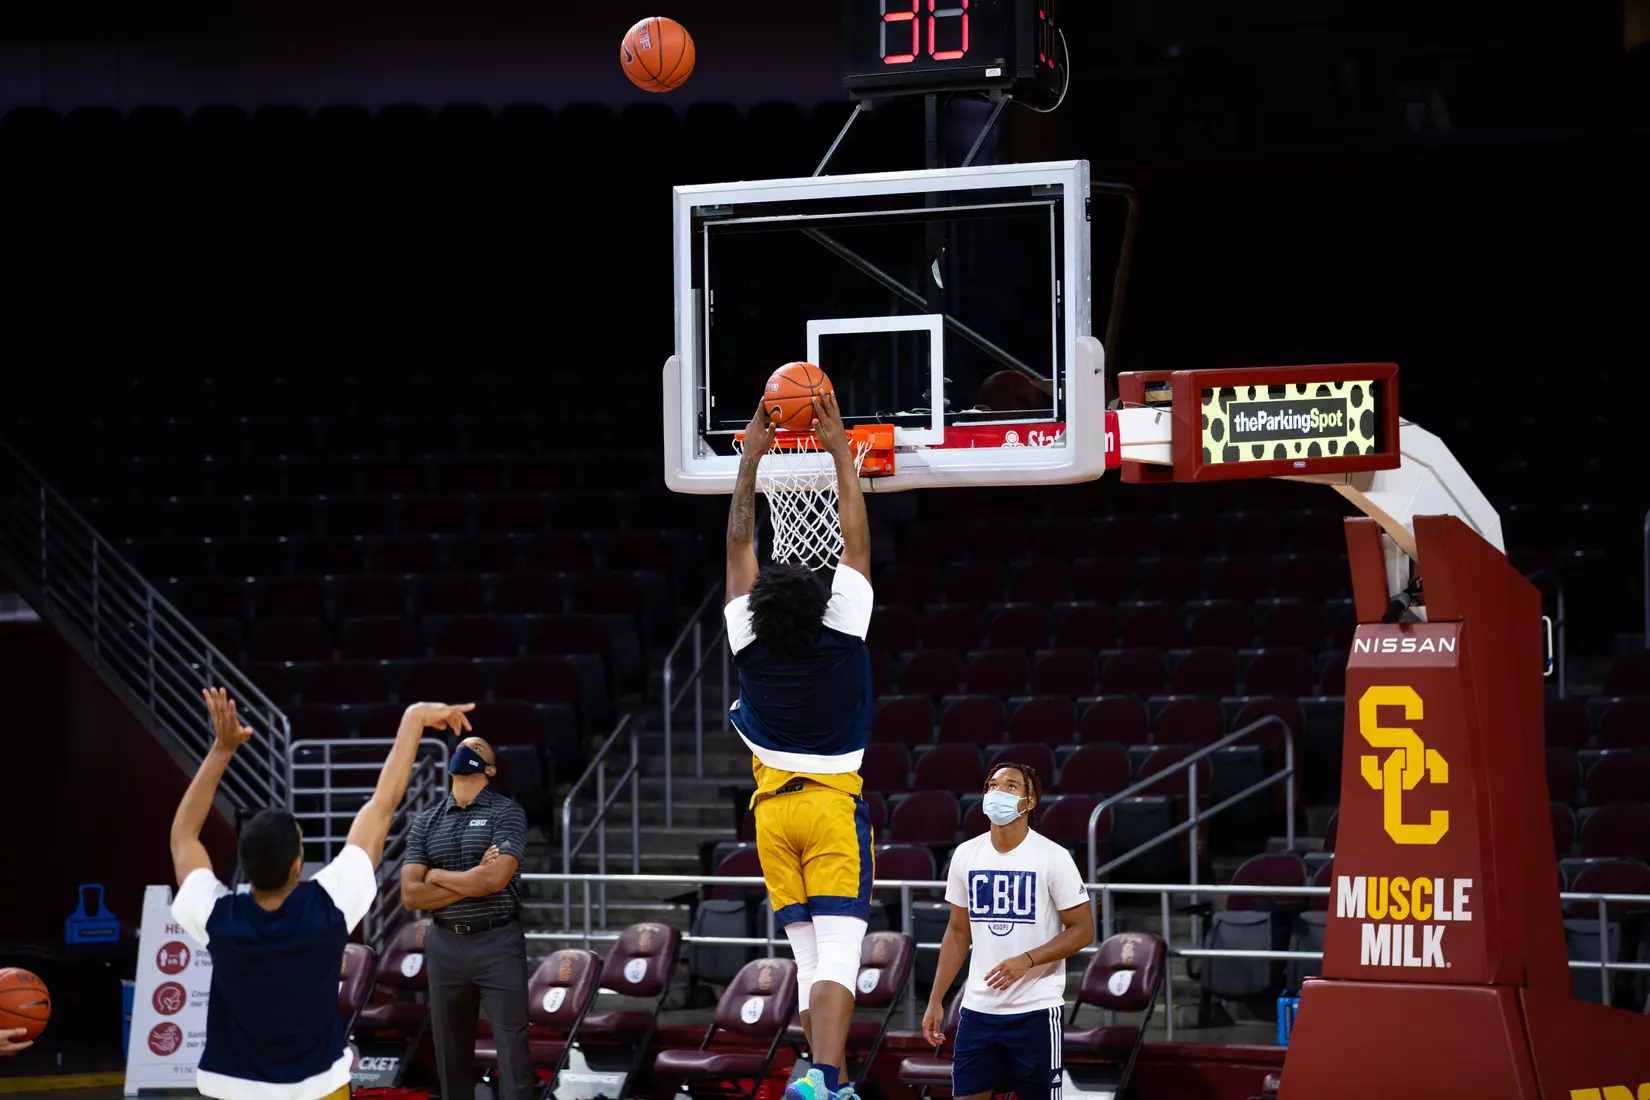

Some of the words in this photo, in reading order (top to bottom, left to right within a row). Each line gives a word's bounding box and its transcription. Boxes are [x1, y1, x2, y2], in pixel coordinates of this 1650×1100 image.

[1353, 637, 1456, 653] NISSAN
[469, 819, 488, 827] CBU
[971, 874, 1033, 916] CBU
[1336, 875, 1473, 922] MUSCLE
